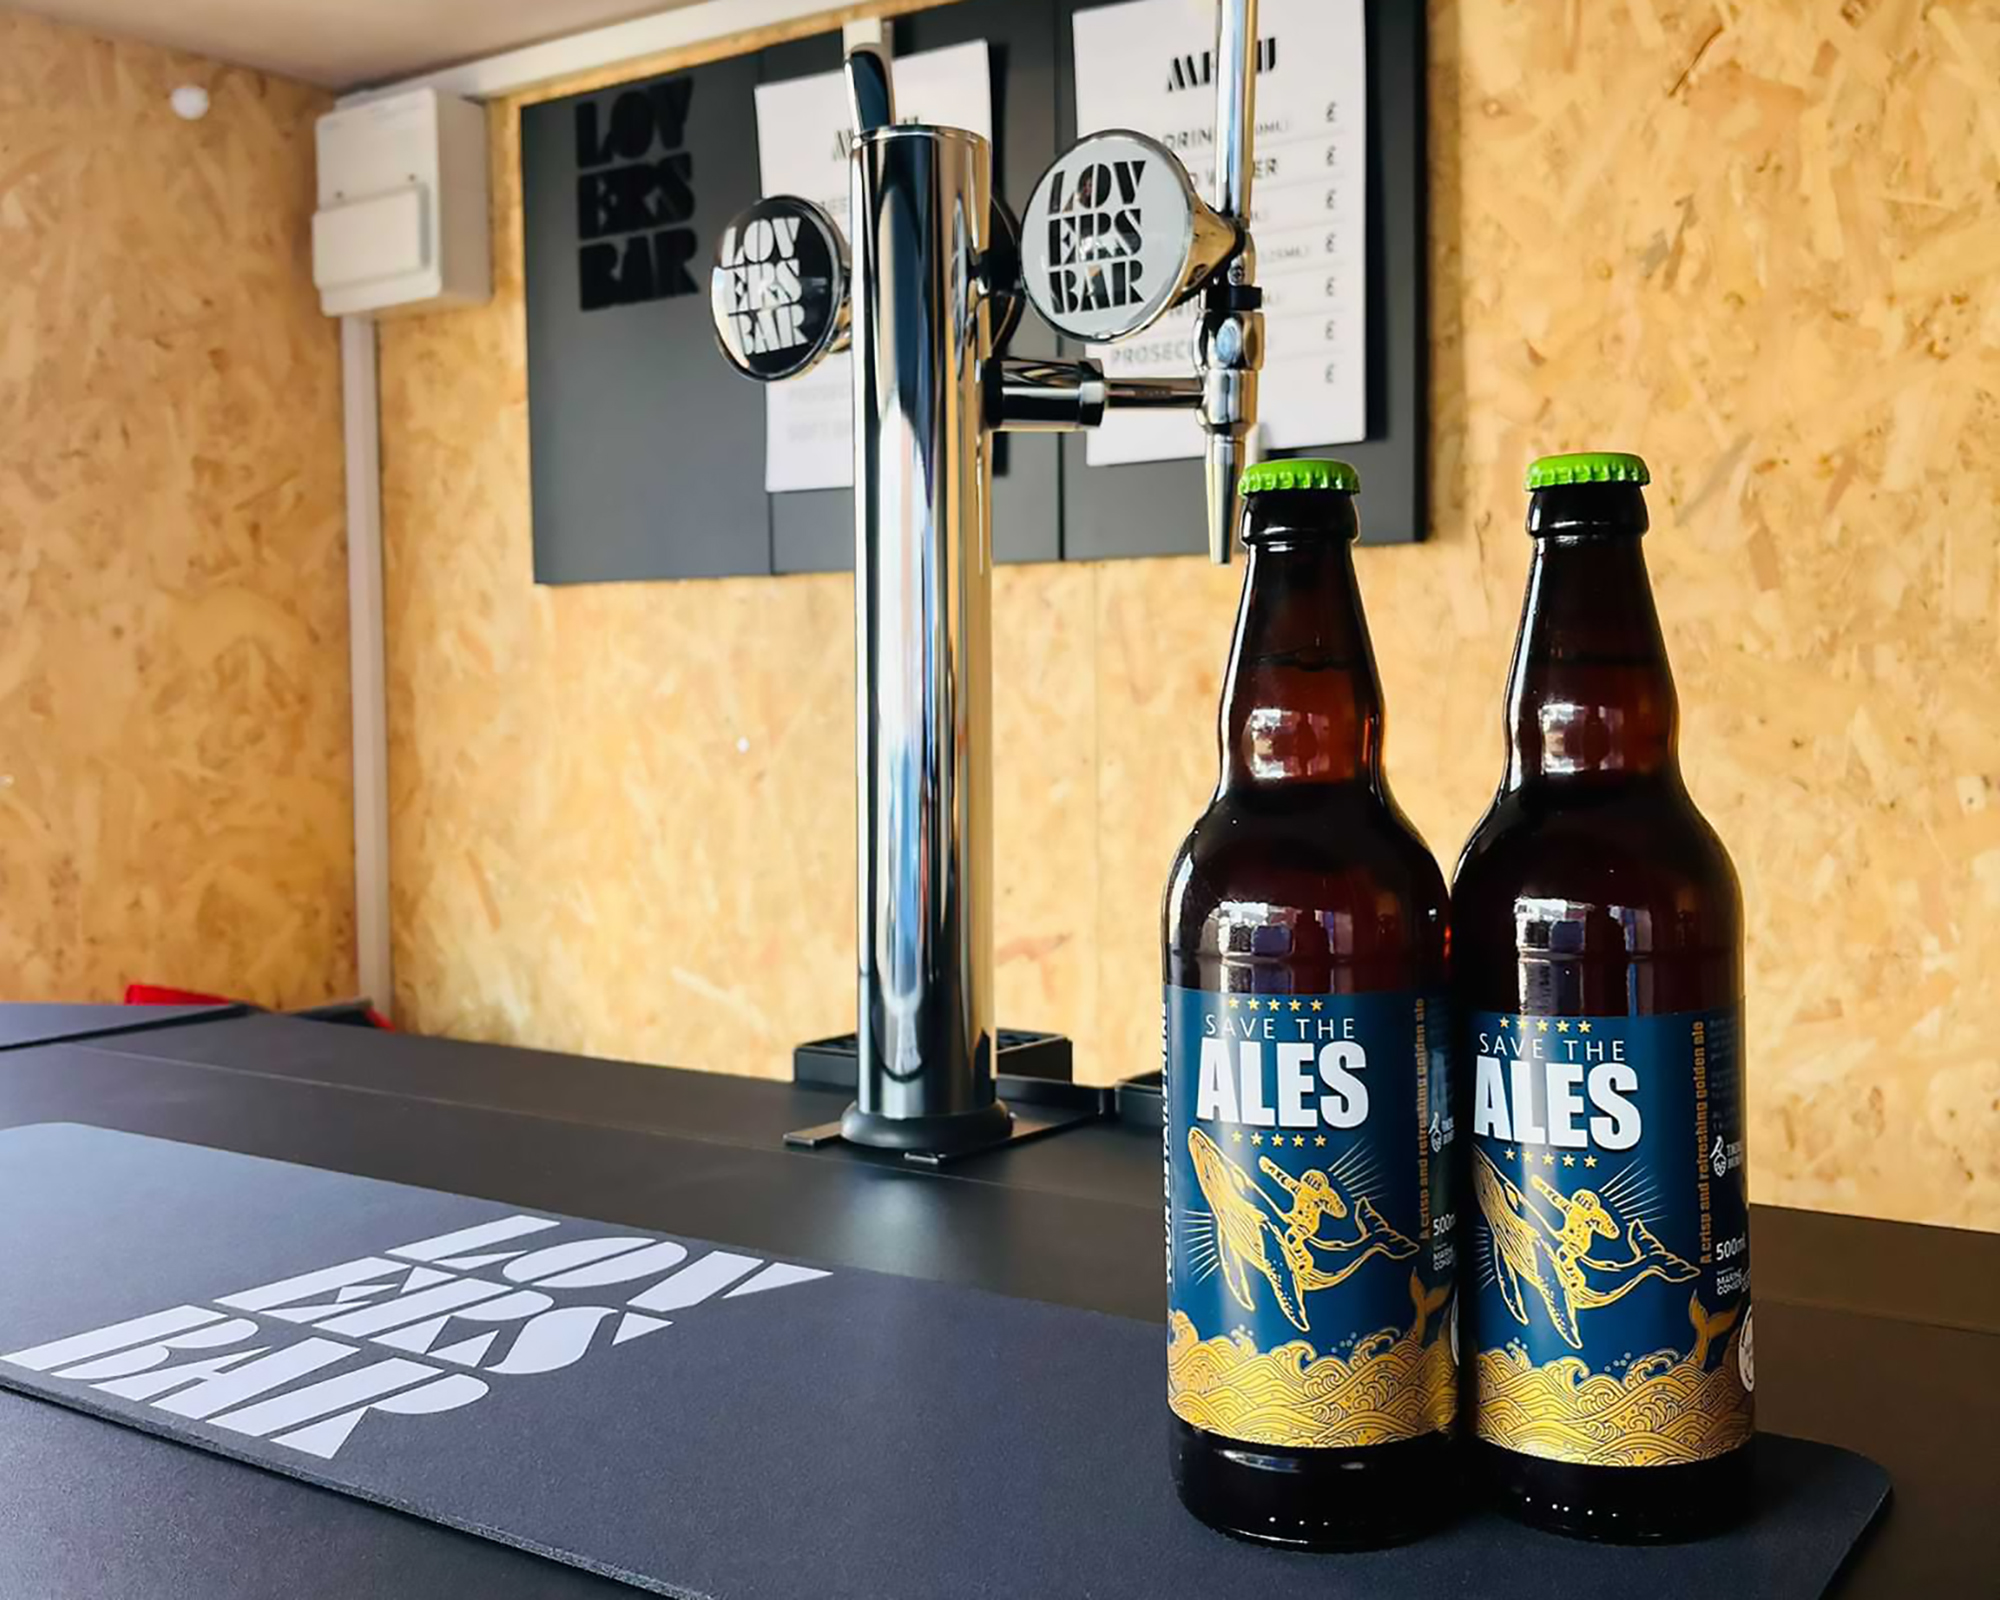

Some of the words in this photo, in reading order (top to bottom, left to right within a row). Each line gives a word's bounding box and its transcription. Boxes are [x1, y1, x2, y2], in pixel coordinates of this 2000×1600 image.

[1166, 37, 1277, 92] MEU
[1046, 160, 1147, 216] LOV
[720, 216, 801, 269] LOV
[1046, 259, 1146, 316] BAR
[1111, 340, 1187, 365] PROSEC
[1205, 1014, 1276, 1040] SAVE
[1295, 1018, 1356, 1040] THE
[1479, 1032, 1543, 1058] SAVE
[1563, 1040, 1626, 1061] THE
[1196, 1036, 1370, 1129] ALES
[1692, 1046, 1708, 1100] golden
[1473, 1055, 1642, 1150] ALES
[1694, 1102, 1709, 1180] refreshing
[1697, 1182, 1710, 1211] and
[1699, 1214, 1712, 1252] crisp
[384, 1215, 834, 1311] LOV
[0, 1304, 490, 1460] BAR
